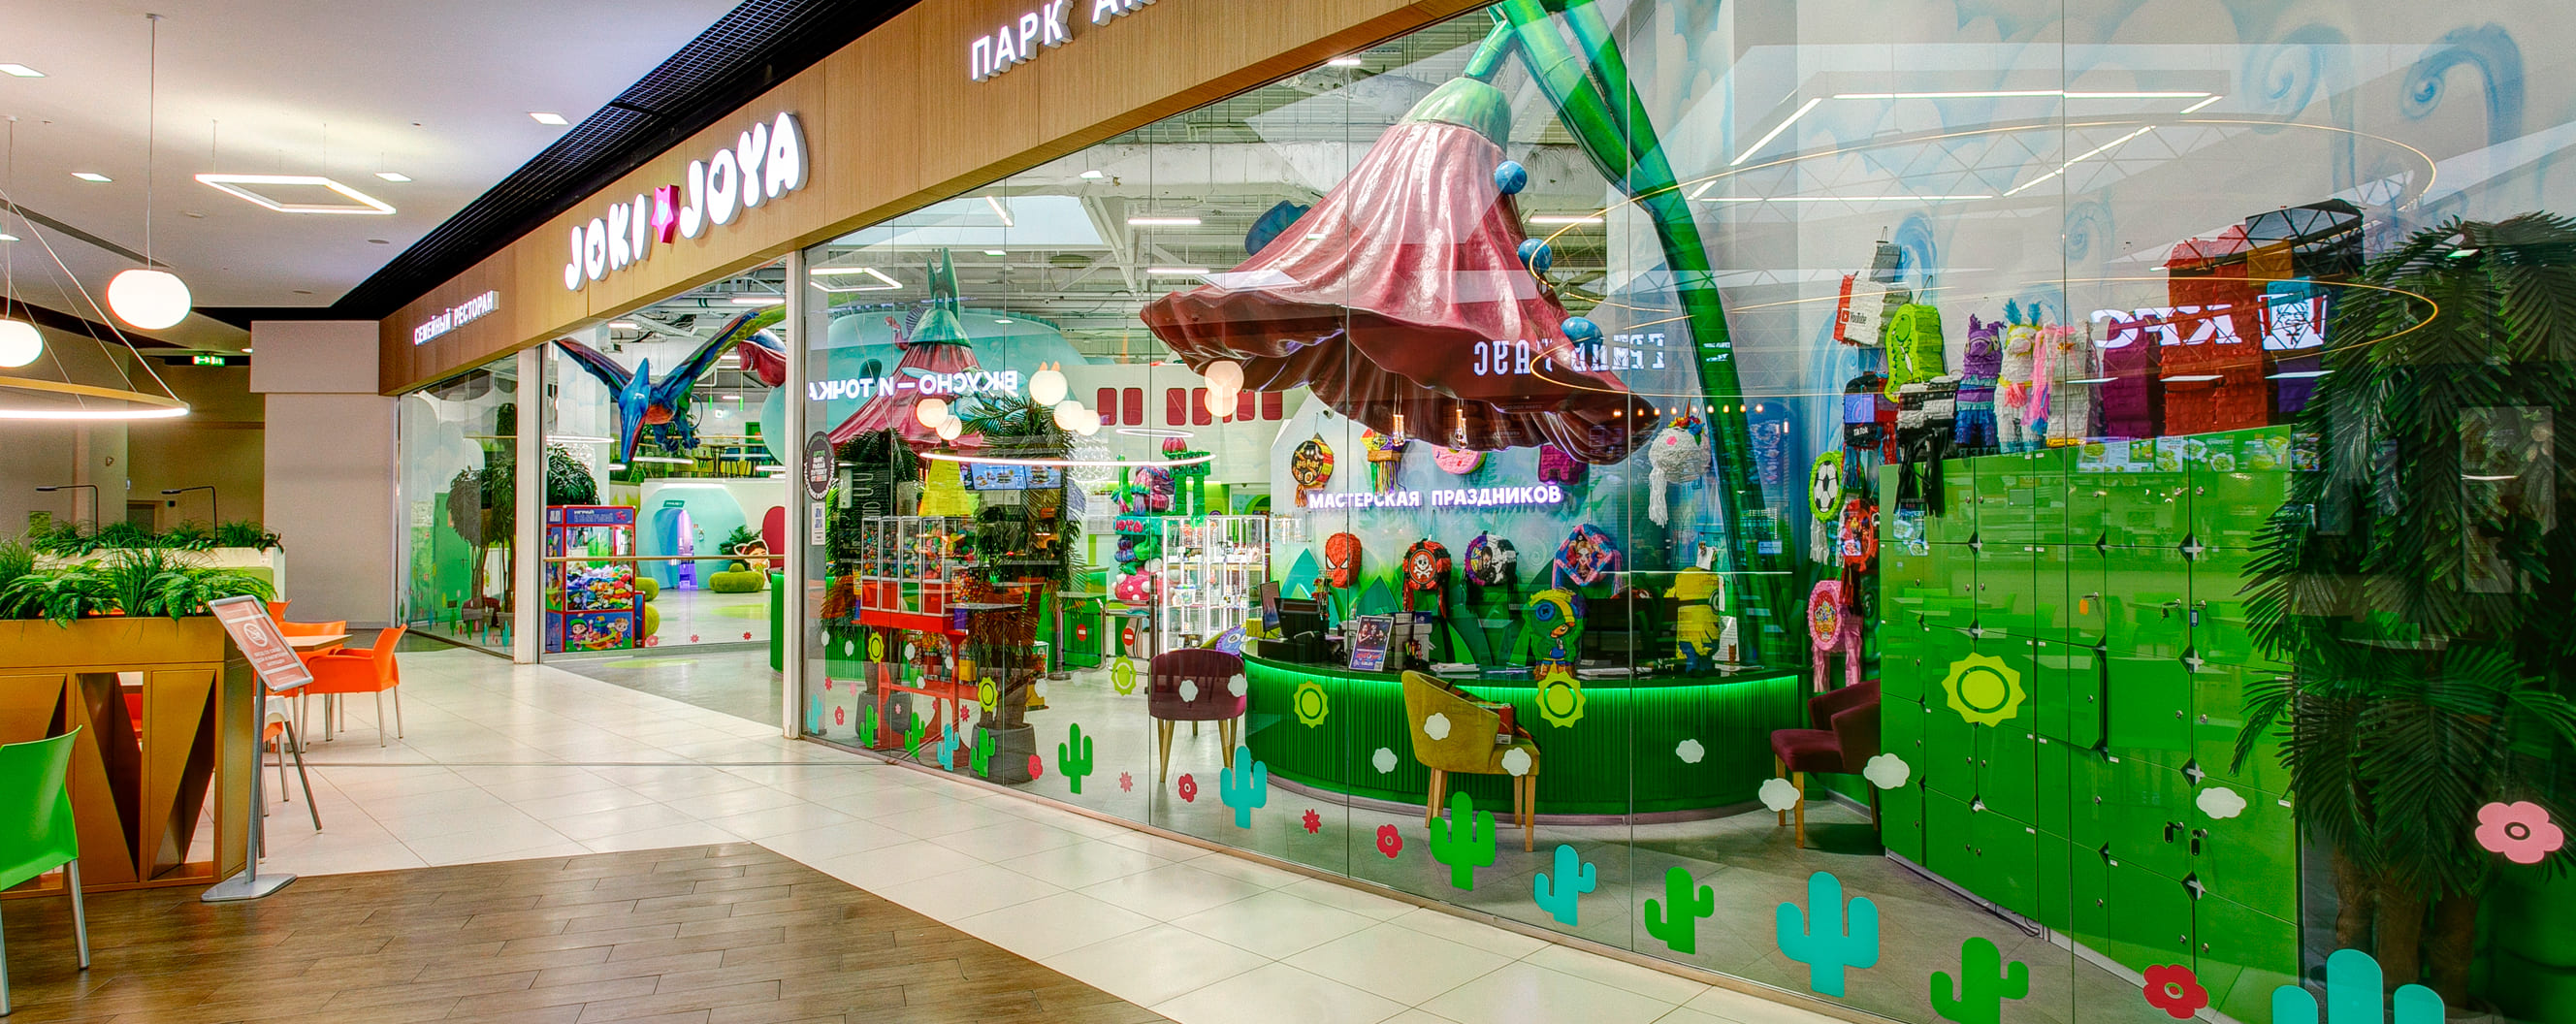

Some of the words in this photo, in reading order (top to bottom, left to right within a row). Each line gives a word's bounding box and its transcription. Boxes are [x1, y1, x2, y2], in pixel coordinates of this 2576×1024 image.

[971, 0, 1064, 81] ПАРК
[564, 194, 648, 291] JOKI
[679, 112, 803, 240] JOYA
[413, 307, 452, 346] СЕМЕЙНЫЙ
[453, 290, 496, 328] РЕСТОРАН
[1308, 490, 1421, 510] МАСТЕРСКАЯ
[1431, 485, 1562, 509] ПРАЗДНИКОВ
